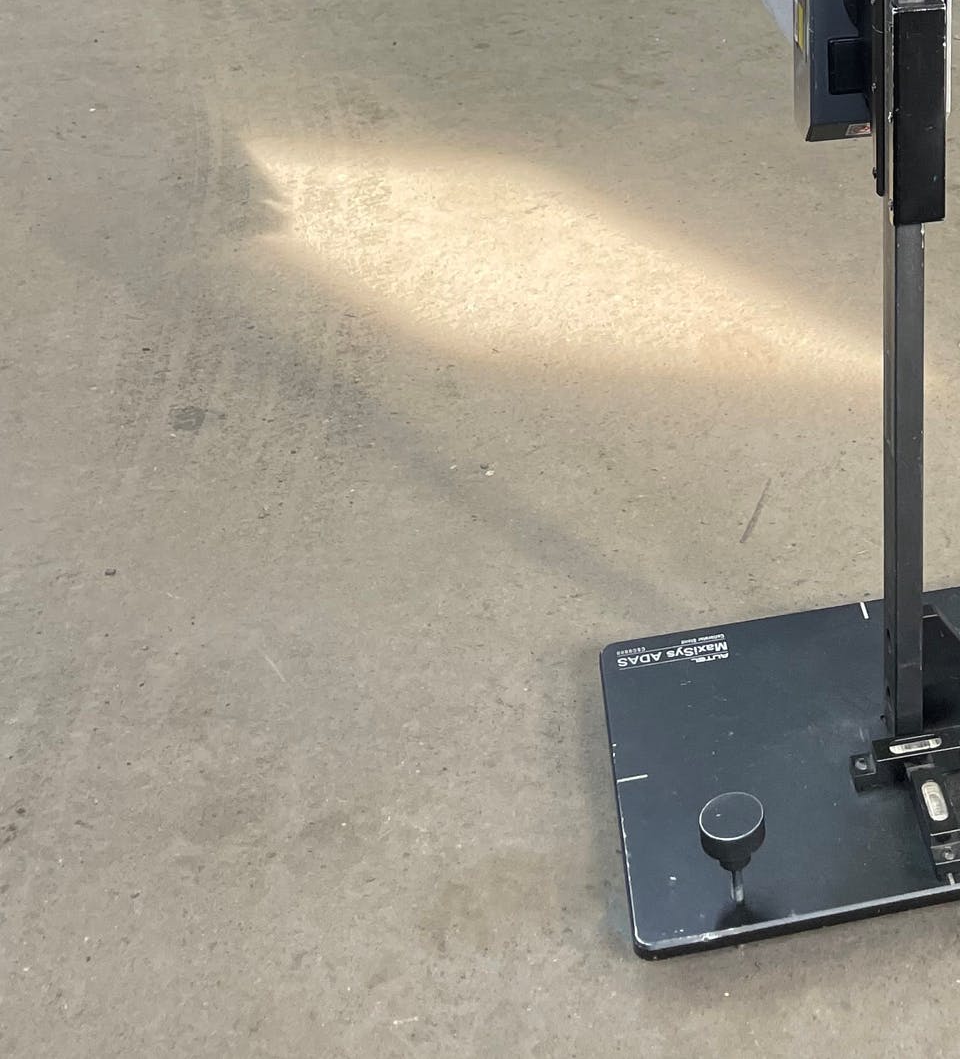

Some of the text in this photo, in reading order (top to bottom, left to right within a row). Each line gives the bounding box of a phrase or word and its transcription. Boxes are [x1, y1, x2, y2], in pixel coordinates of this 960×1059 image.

[617, 641, 728, 667] MaxiSys ADAS
[691, 653, 729, 663] AUTEL
